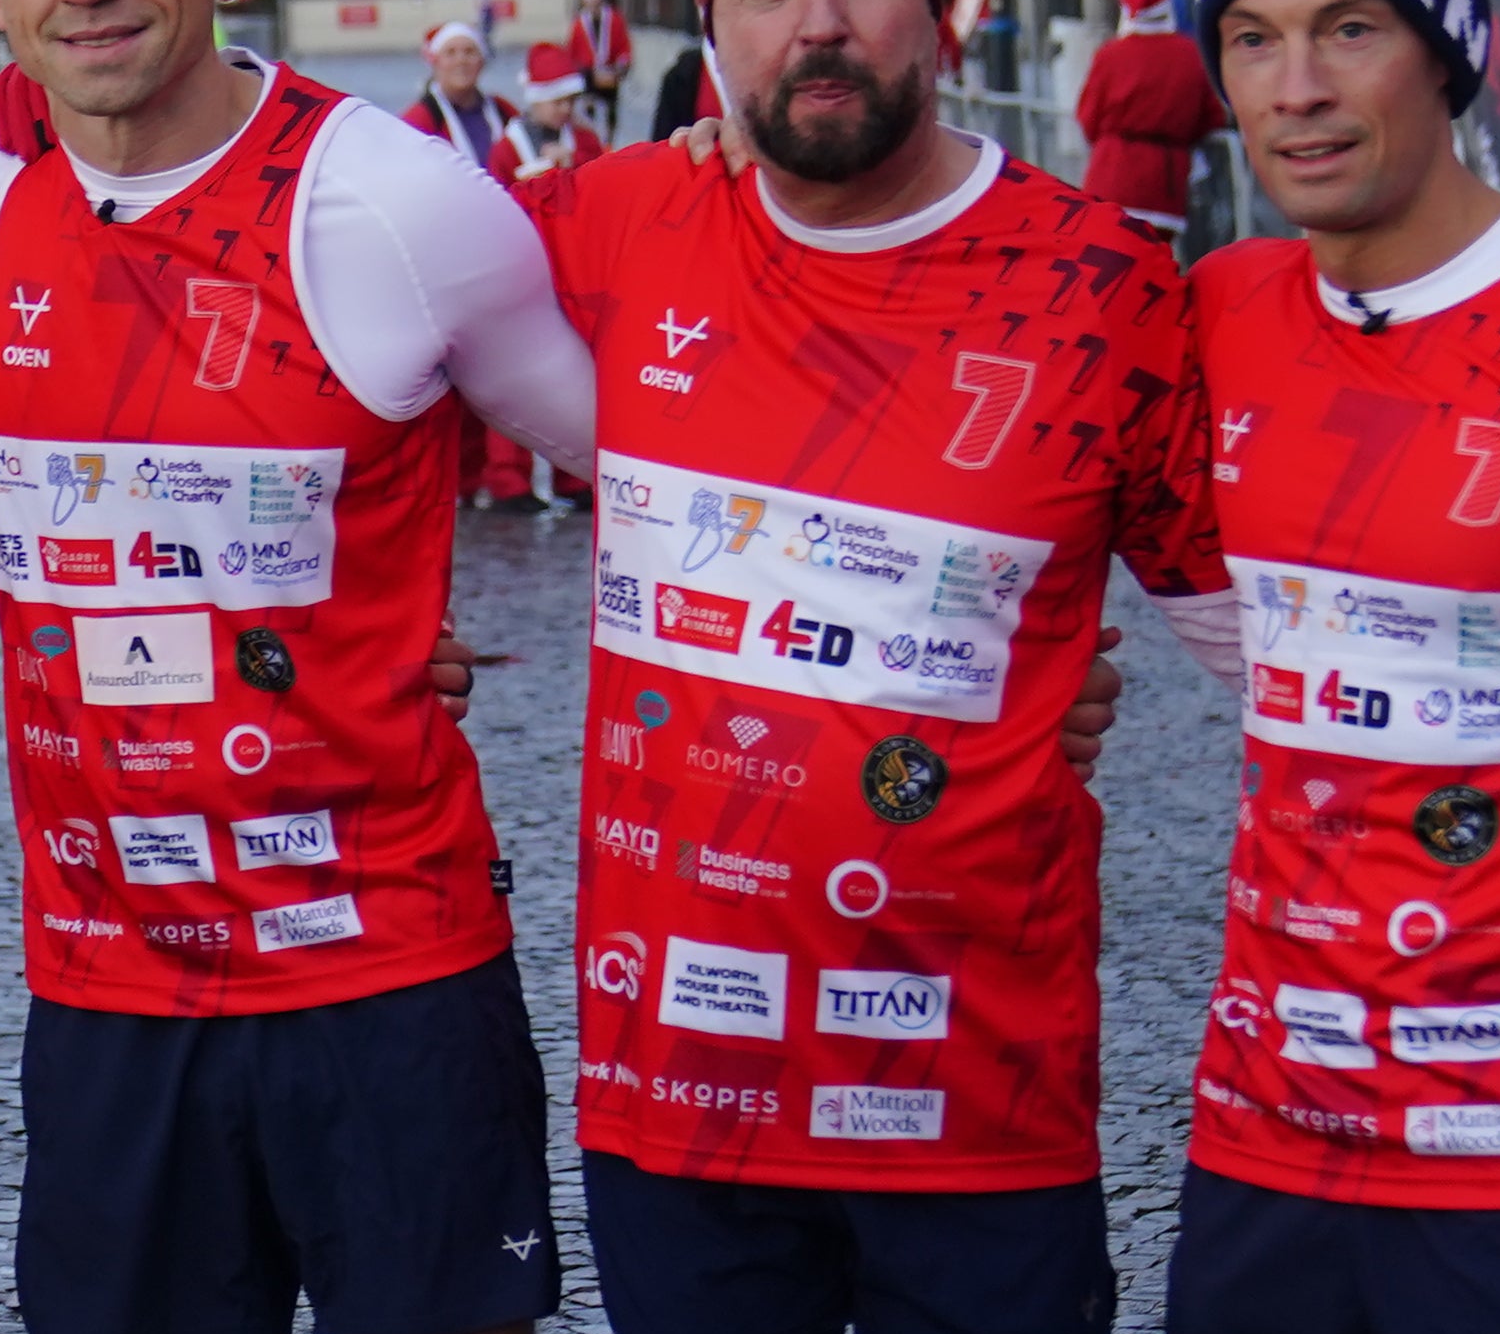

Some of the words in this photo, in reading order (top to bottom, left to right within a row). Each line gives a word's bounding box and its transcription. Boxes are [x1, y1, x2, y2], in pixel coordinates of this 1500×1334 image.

[185, 277, 262, 392] 7
[2, 345, 51, 369] OXEN
[638, 364, 694, 395] OXEN
[941, 350, 1038, 471] 7
[158, 458, 204, 474] Leeds
[165, 475, 233, 490] Hospitals
[170, 490, 226, 505] Charity
[833, 517, 889, 543] Leeds
[251, 540, 293, 559] MND
[837, 537, 920, 568] Hospitals
[250, 553, 321, 576] Scotland
[838, 554, 907, 585] Charity
[923, 637, 976, 661] MND
[85, 669, 205, 688] AssuredPartners
[117, 737, 195, 757] business
[120, 755, 172, 773] waste
[685, 743, 808, 788] ROMERO
[1269, 808, 1371, 841] ROMERO
[241, 825, 319, 857] TITAN
[700, 843, 792, 881] business
[698, 868, 759, 895] waste
[42, 912, 84, 935] Shark
[280, 897, 350, 925] Mattioli
[284, 920, 347, 943] Woods
[584, 944, 642, 1001] ACS
[685, 961, 761, 985] KILWORTH
[675, 975, 721, 996] HOUSE
[723, 985, 771, 1003] HOTEL
[827, 986, 928, 1018] TITAN
[1398, 1021, 1500, 1045] TITAN
[650, 1076, 781, 1114] SKOPES
[848, 1090, 936, 1113] Mattioli
[849, 1112, 922, 1134] Woods
[1277, 1103, 1379, 1138] SKOPES
